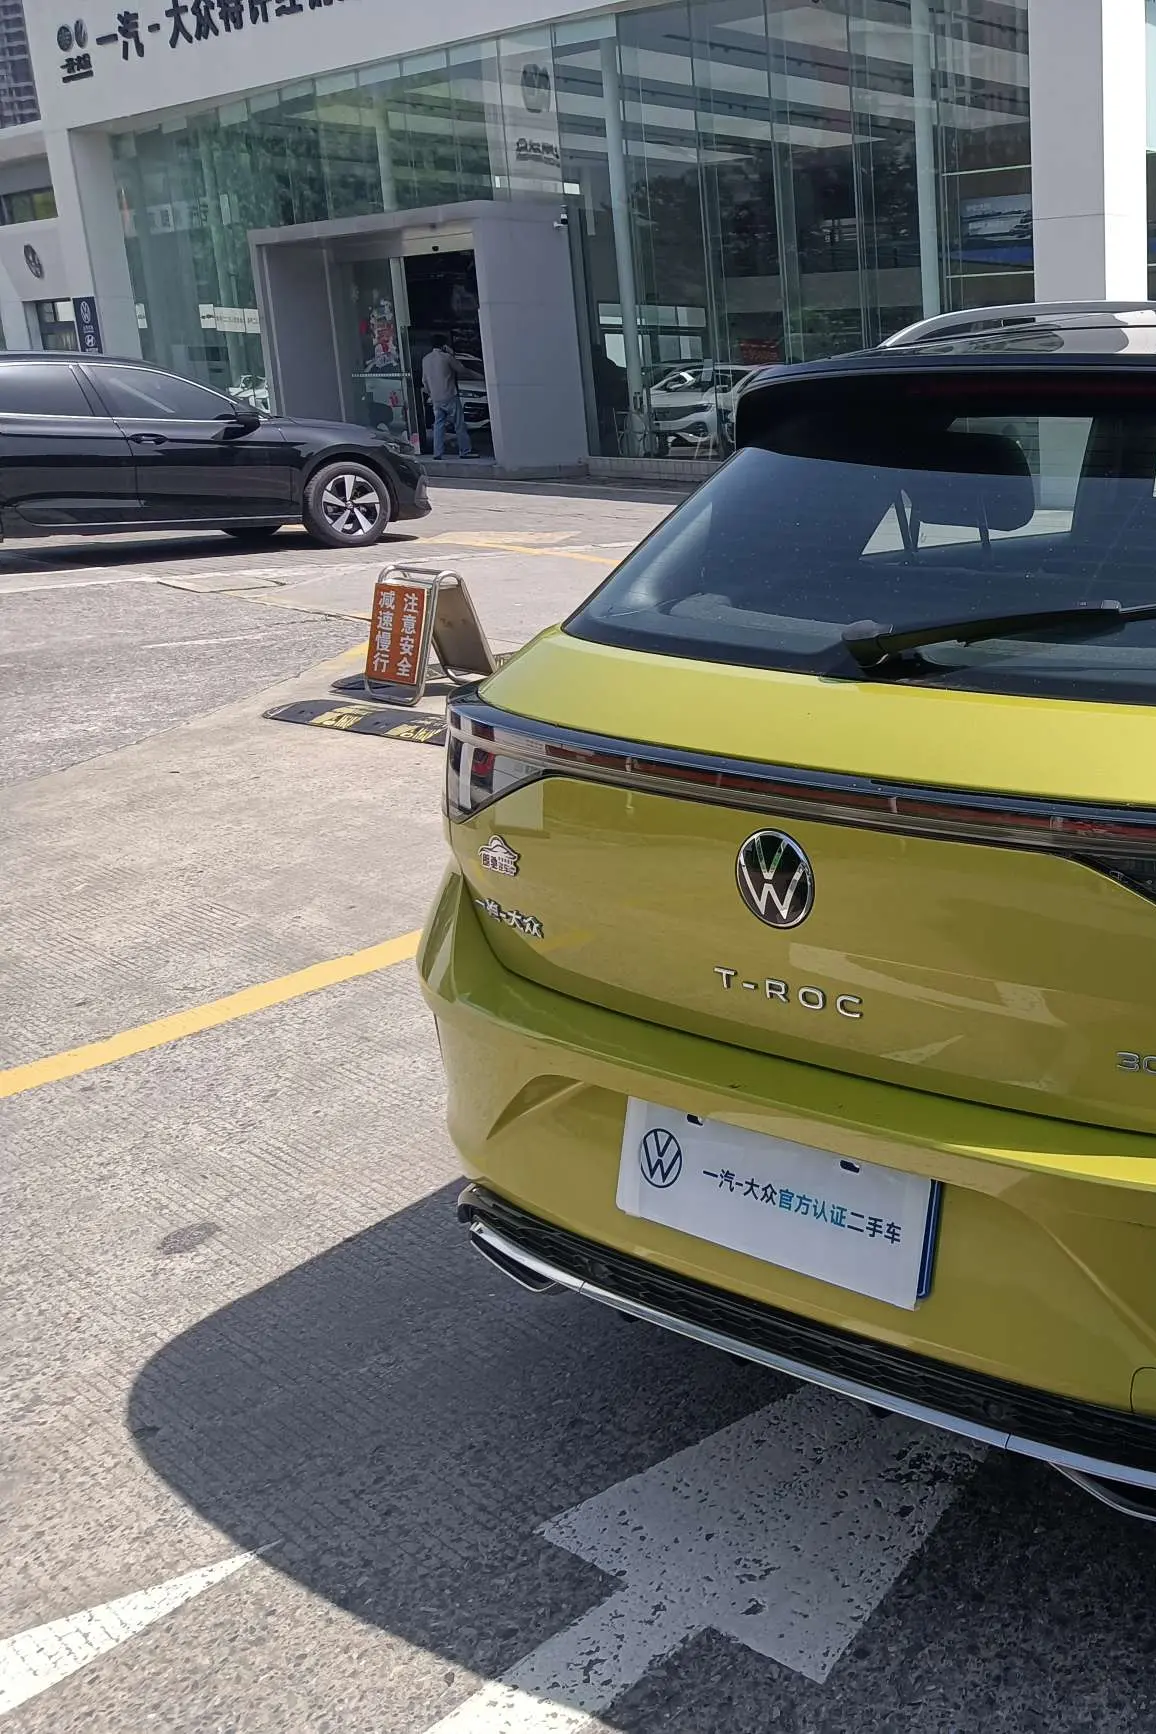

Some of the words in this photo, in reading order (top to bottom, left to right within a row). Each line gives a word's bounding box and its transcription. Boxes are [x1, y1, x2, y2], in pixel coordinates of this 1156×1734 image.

[372, 590, 396, 673] 减速慢行
[396, 592, 419, 677] 注意安全
[475, 899, 543, 938] 一汽-大众
[713, 966, 864, 1018] T-ROC
[702, 1168, 902, 1245] 一汽-大众官方认证二手车
